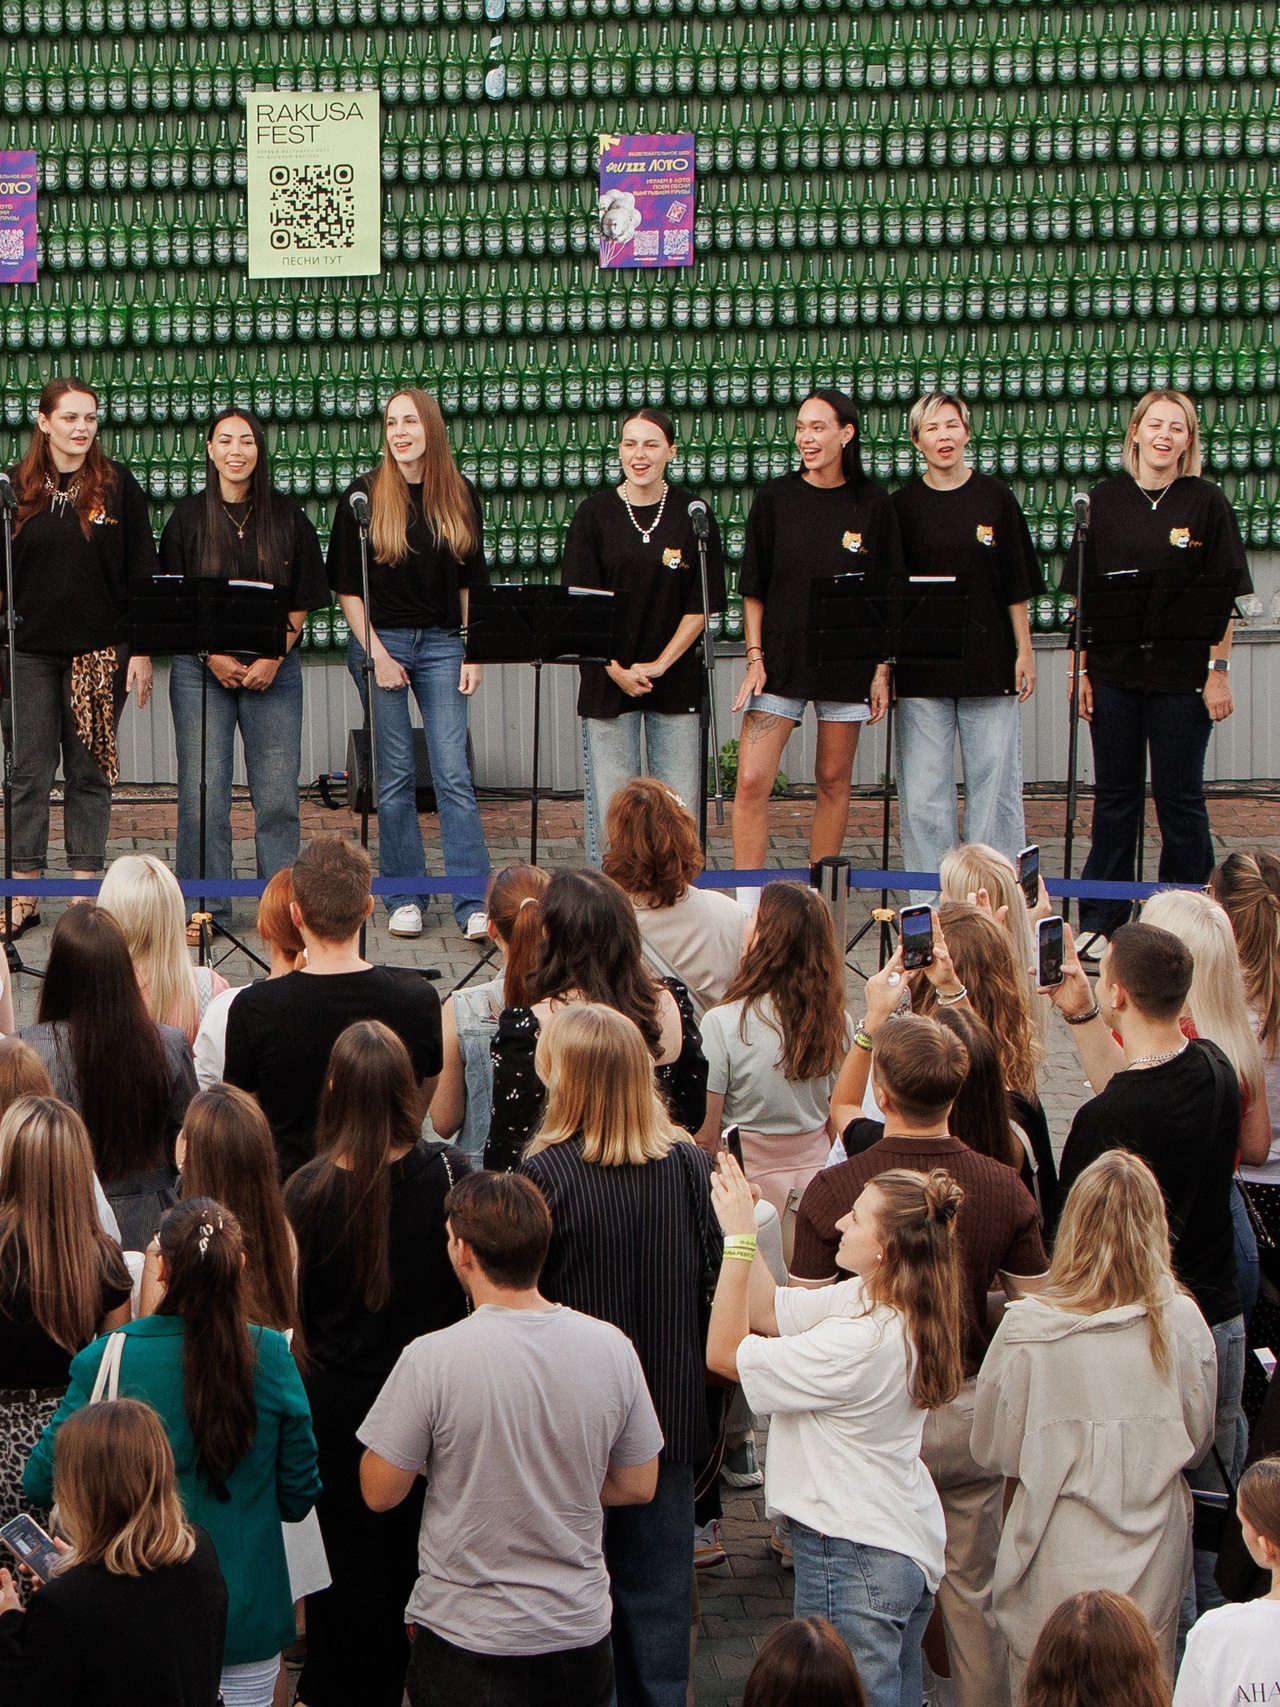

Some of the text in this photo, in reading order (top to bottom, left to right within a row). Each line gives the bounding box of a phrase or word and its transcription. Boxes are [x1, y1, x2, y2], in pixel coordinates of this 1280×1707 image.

[256, 102, 364, 123] RAKUSA
[256, 124, 321, 145] FEST
[649, 159, 688, 171] ЛОТО
[282, 255, 344, 266] ПЕСНИ ТУТ
